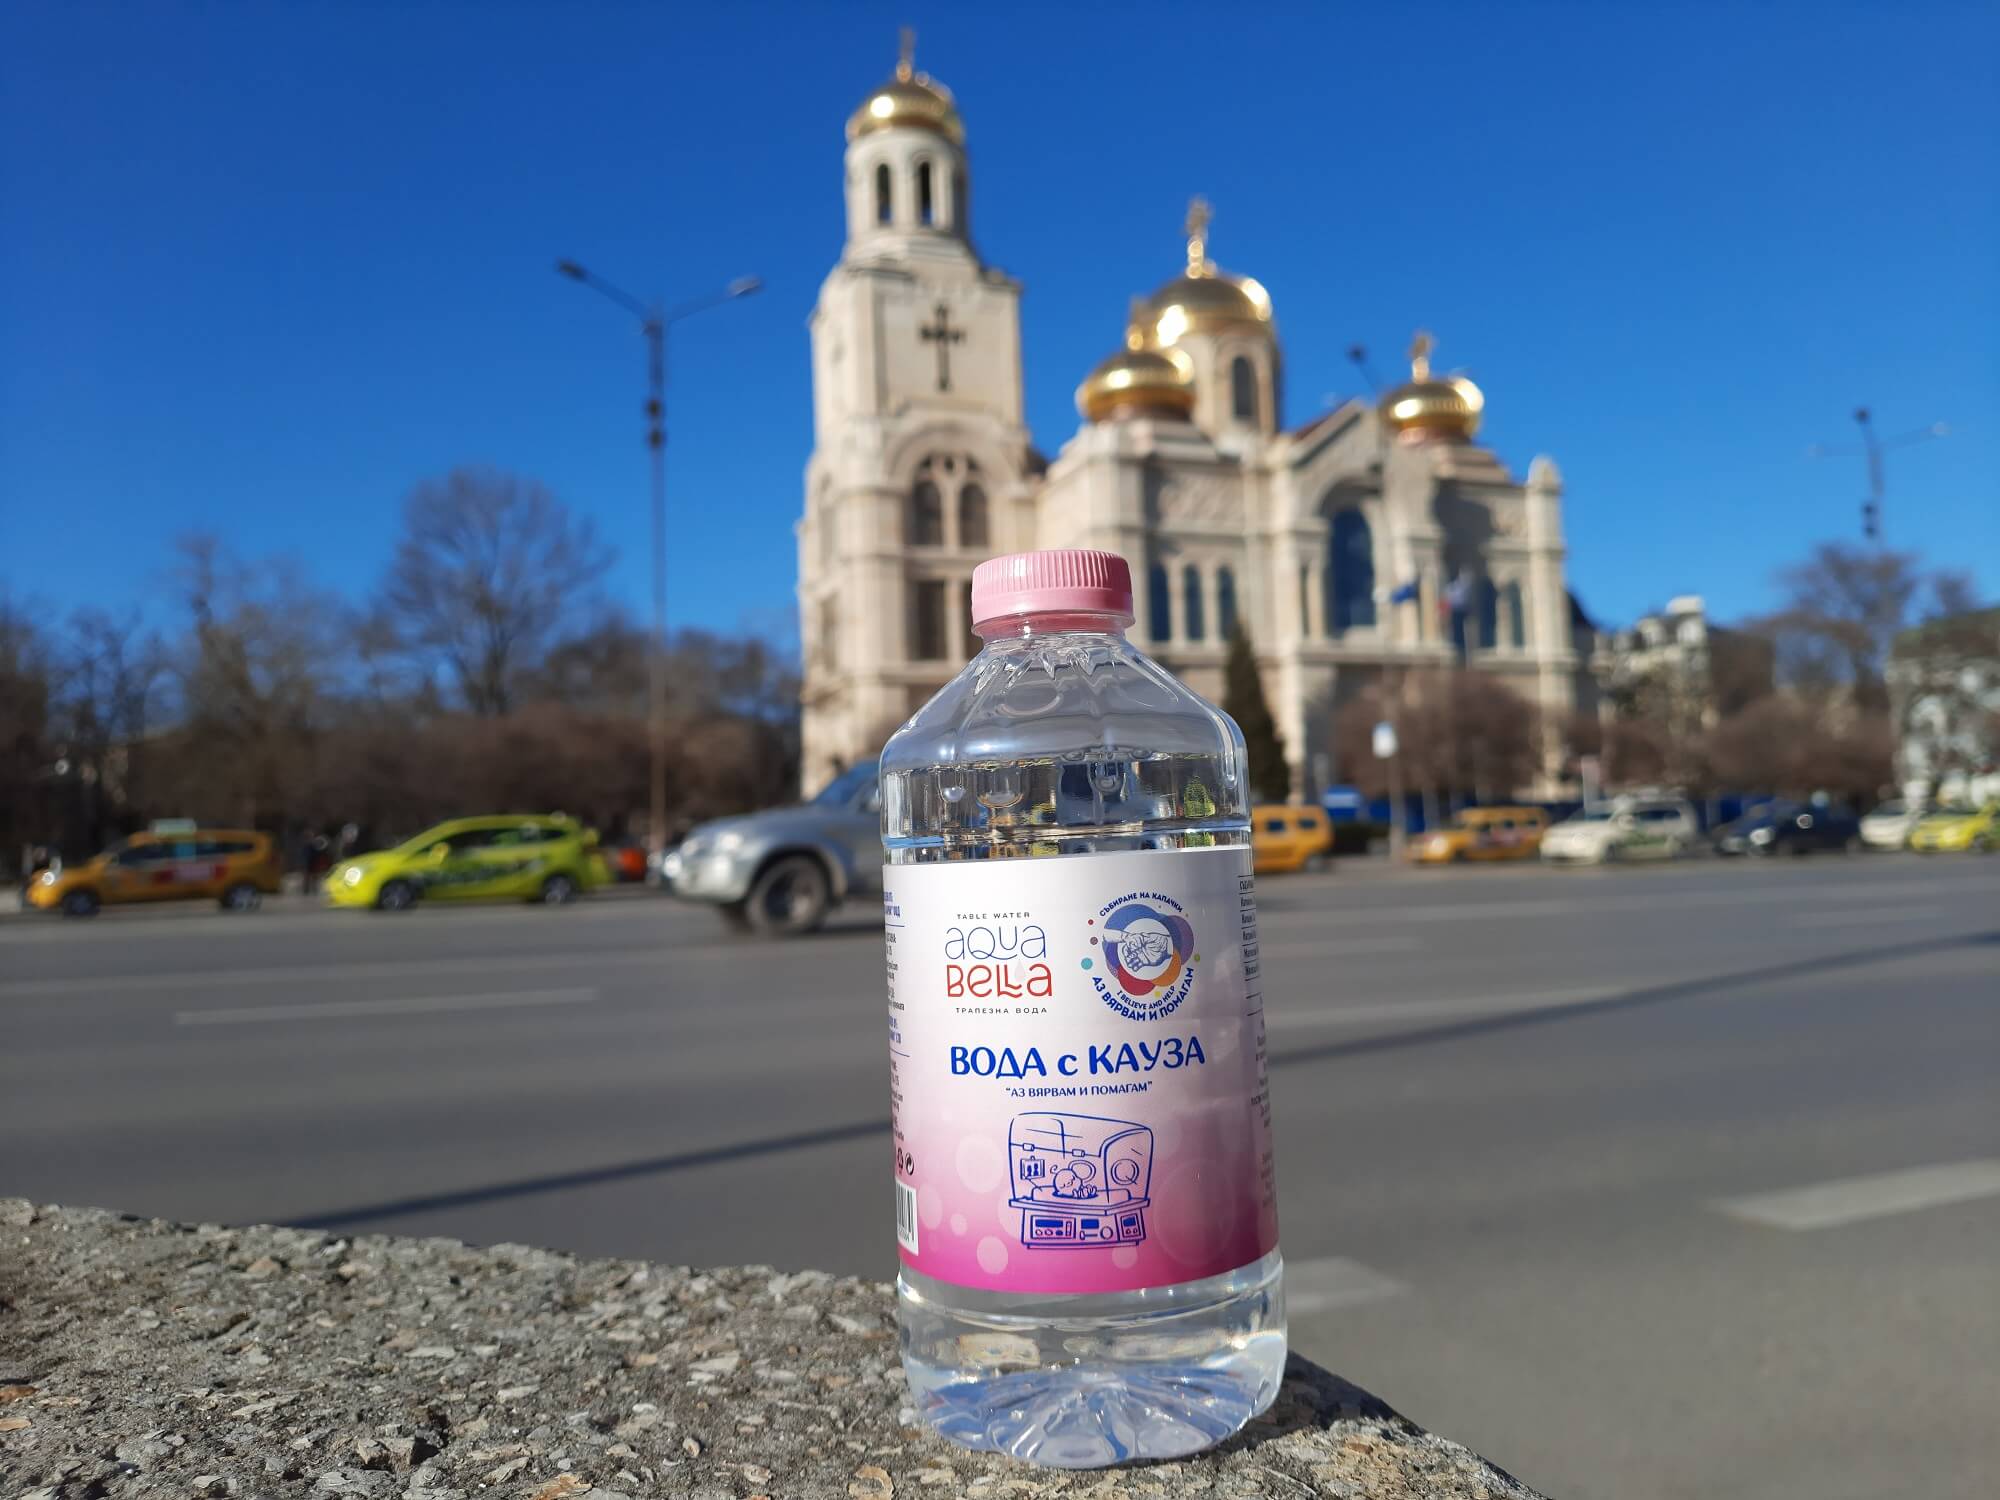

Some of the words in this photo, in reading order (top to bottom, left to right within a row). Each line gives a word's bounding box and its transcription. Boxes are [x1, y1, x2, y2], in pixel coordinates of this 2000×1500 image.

[1099, 892, 1138, 917] СЪБИРАНЕ
[1152, 892, 1184, 912] КАПАЧКИ
[1092, 976, 1106, 993] АЗ
[1102, 992, 1146, 1022] ВЯРВАМ
[1149, 1011, 1158, 1022] И
[1159, 967, 1194, 1018] ПОМАГАМ
[1120, 994, 1147, 1010] BELIEVE
[1148, 1000, 1163, 1010] AND
[1162, 985, 1175, 1003] HELP
[950, 1046, 1047, 1080] ВОДА
[1088, 1036, 1206, 1075] КАУЗА
[1028, 1086, 1076, 1098] ВЯРВАМ
[1080, 1086, 1088, 1096] И
